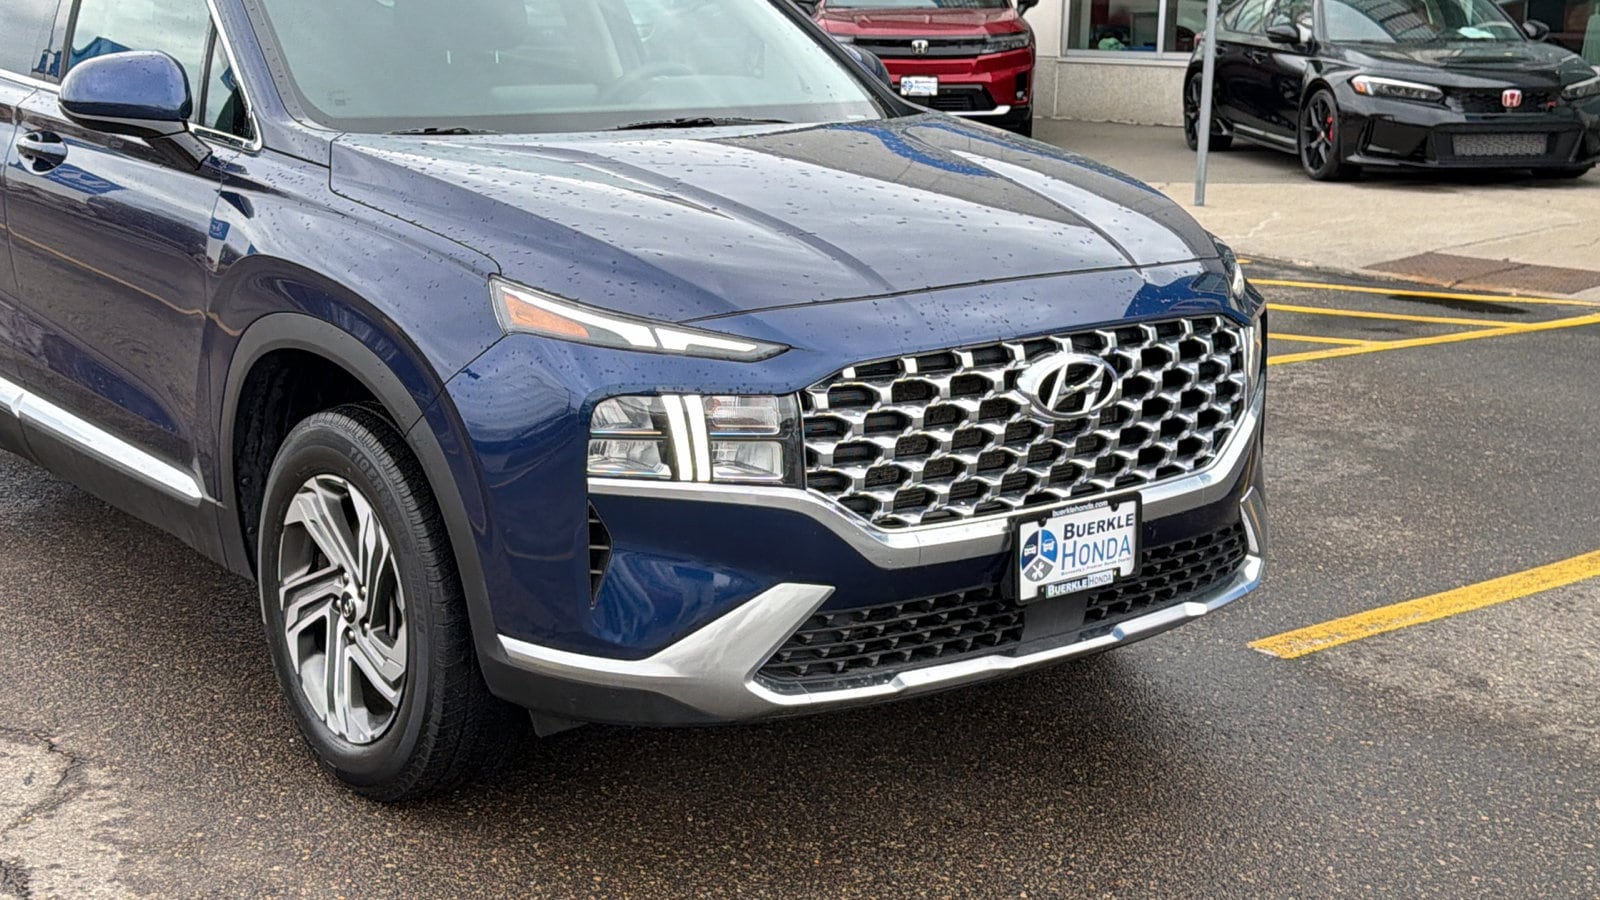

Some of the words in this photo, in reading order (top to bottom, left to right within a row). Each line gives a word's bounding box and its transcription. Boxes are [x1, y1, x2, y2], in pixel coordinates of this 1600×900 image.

[348, 446, 384, 491] TIGER
[1064, 513, 1134, 540] BUERKLE
[1061, 535, 1131, 570] HONDA
